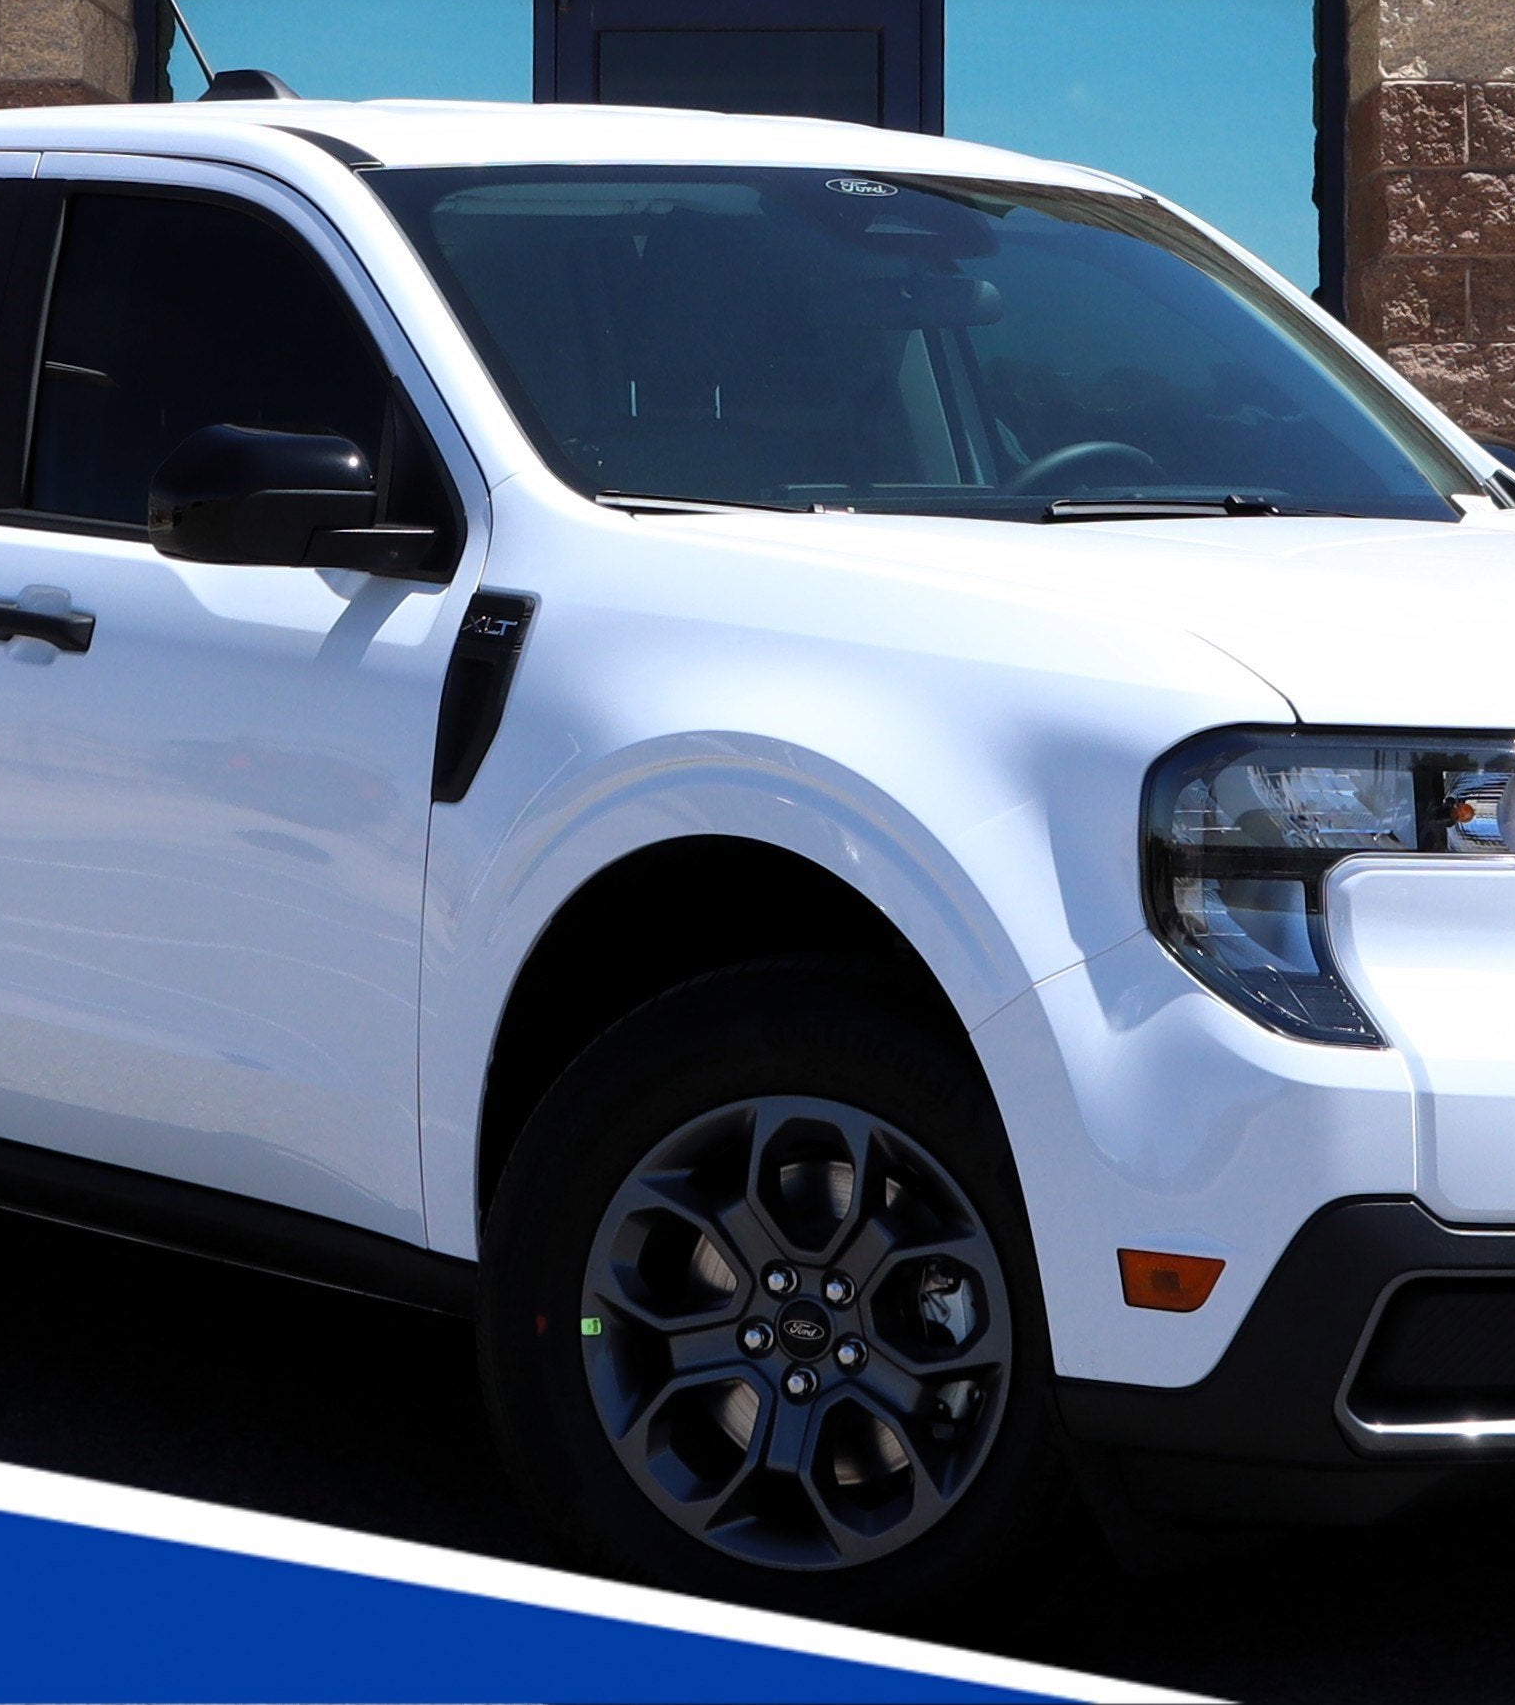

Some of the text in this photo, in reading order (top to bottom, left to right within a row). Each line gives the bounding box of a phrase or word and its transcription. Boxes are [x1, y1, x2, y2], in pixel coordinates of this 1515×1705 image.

[840, 181, 887, 194] Ford
[461, 615, 519, 636] XLT
[789, 1322, 818, 1337] Ford
